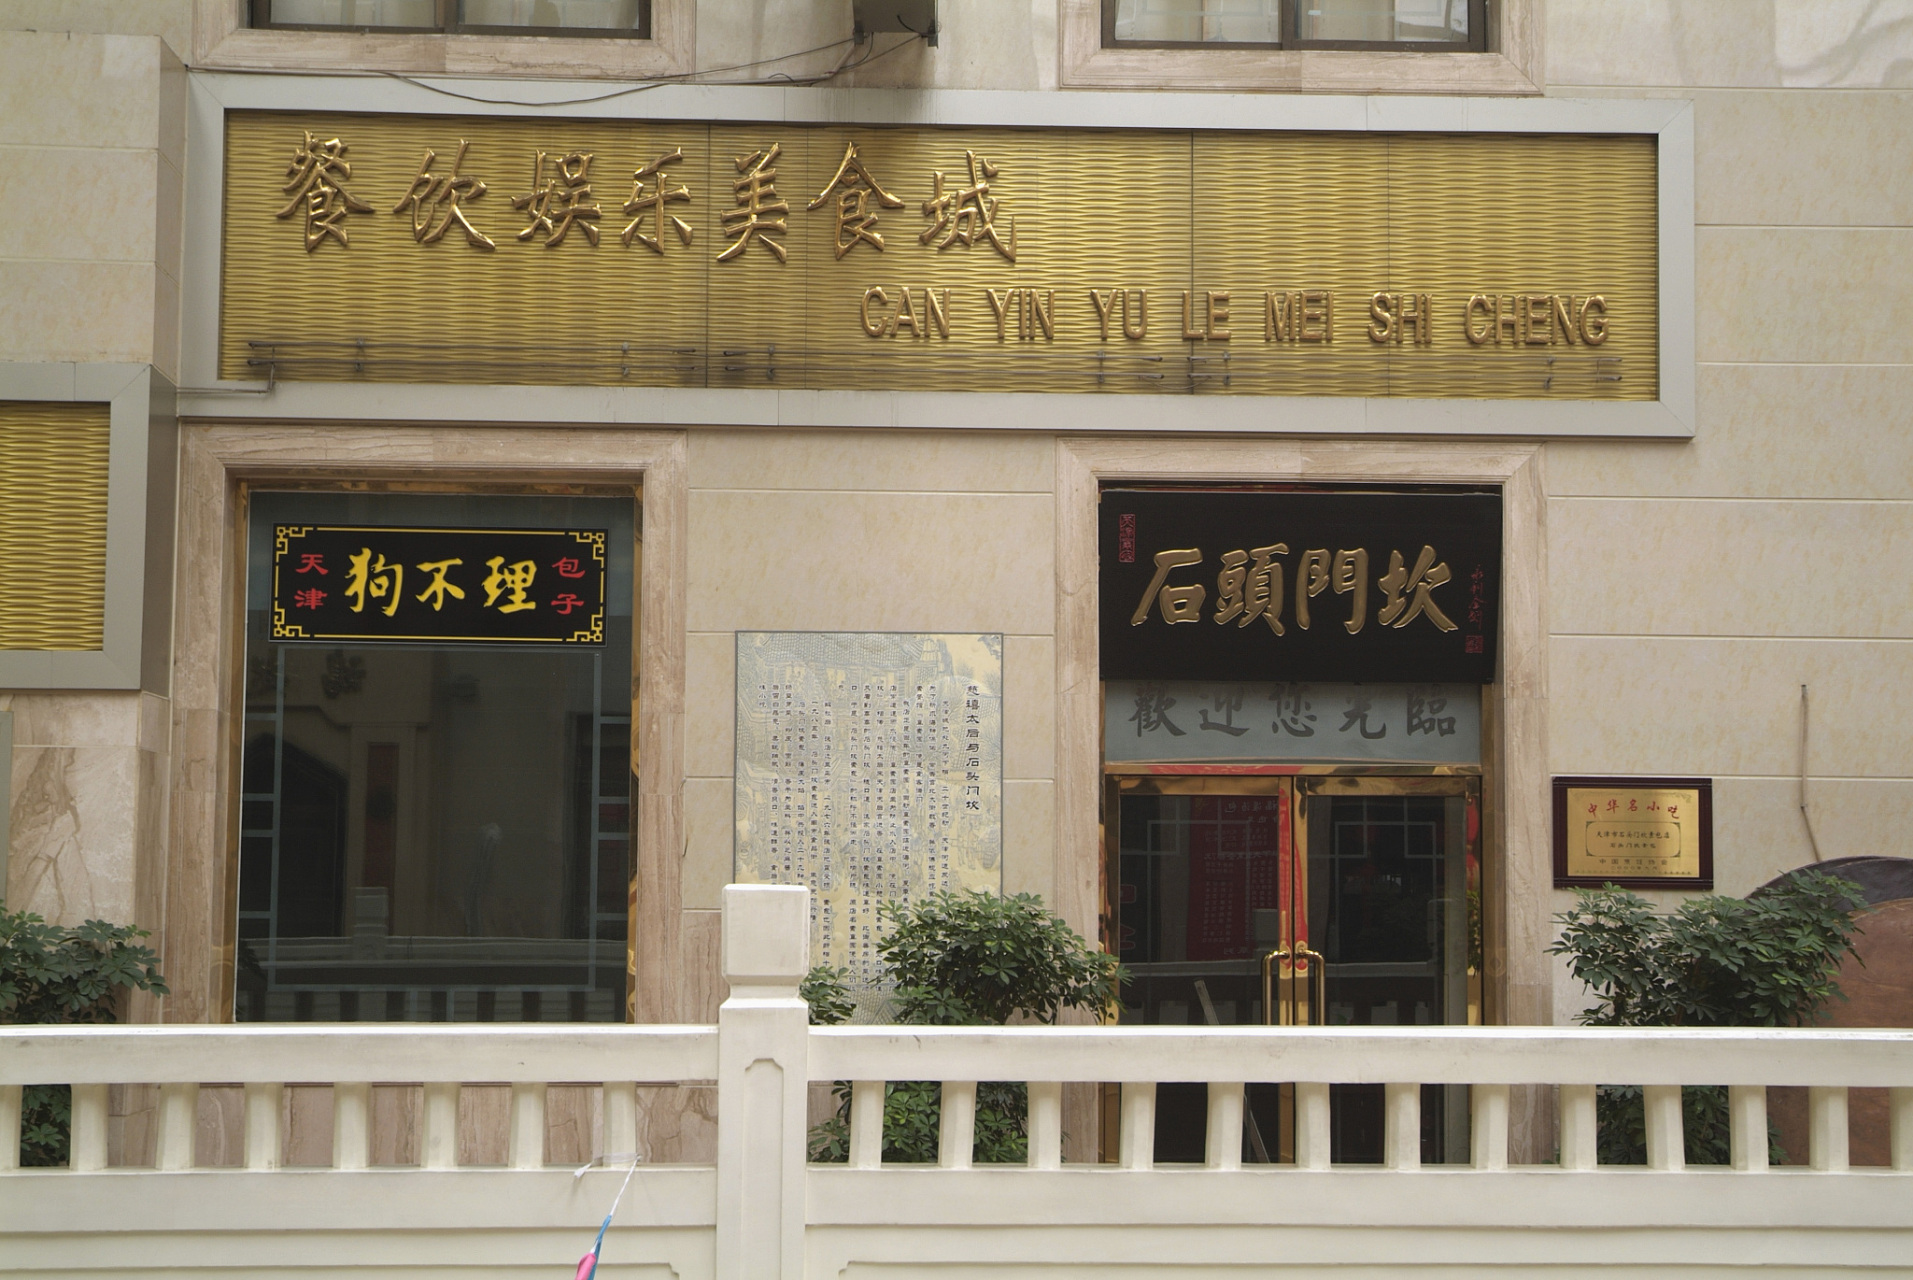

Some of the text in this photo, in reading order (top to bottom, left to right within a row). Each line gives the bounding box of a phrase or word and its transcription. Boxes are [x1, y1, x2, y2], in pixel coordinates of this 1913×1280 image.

[275, 129, 1017, 264] 餐饮娱乐美食城
[860, 285, 1610, 346] CAN YIN YU LE MEI SHI CHENG
[293, 553, 329, 610] 天津
[344, 547, 538, 617] 狗不理
[550, 556, 586, 615] 包子
[1130, 542, 1460, 637] 石頭門坎
[965, 684, 981, 811] 慈禧太后与石头门坎
[1587, 798, 1680, 819] 中华名小吃
